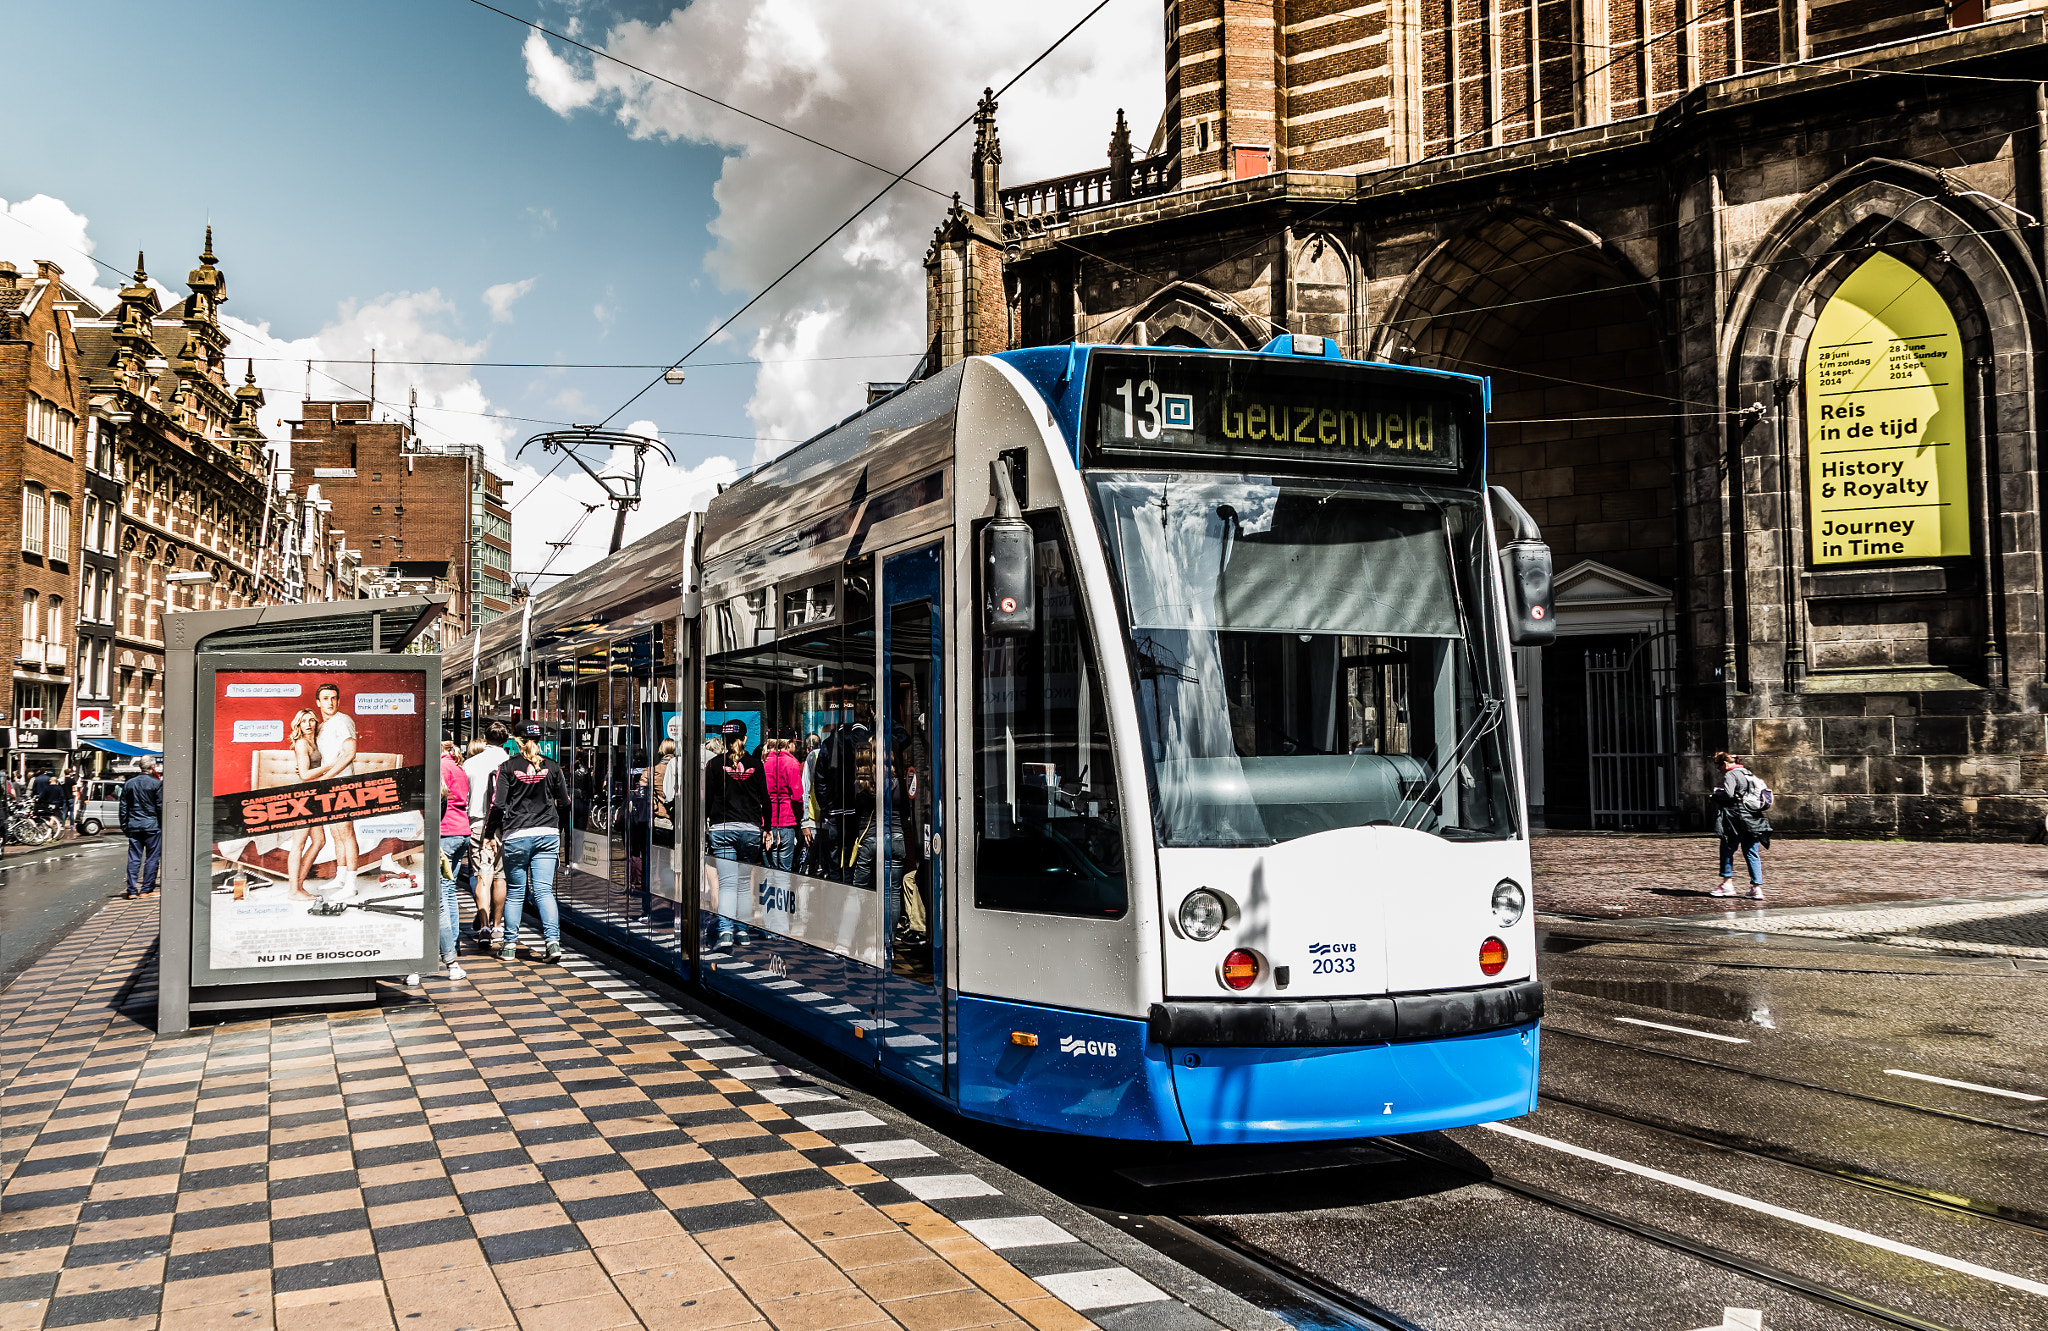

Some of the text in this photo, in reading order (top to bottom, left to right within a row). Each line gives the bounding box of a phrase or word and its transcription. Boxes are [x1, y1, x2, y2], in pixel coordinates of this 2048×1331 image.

[1831, 351, 1850, 362] juni
[1889, 343, 1926, 353] 28 June
[1889, 350, 1948, 362] until Sunday
[1819, 357, 1871, 369] t/m zondag
[1889, 361, 1927, 371] 14 Sept.
[1819, 368, 1854, 379] 14 sept.
[1889, 371, 1913, 380] 2014
[1819, 378, 1842, 387] 2014
[1116, 378, 1434, 452] 13 Geuzenveld
[1820, 402, 1866, 420] Reis
[1820, 418, 1918, 441] in de tijd
[1822, 461, 1904, 478] History
[1822, 478, 1929, 499] & Royalty
[1822, 520, 1915, 537] Journey
[1822, 539, 1904, 557] in Time
[298, 657, 347, 667] JCDecaux
[241, 776, 396, 806] CAMERON DIAZ JASON SEGEL
[242, 783, 399, 824] SEX TAPE
[246, 804, 402, 834] THEIR PRIVATES HAVE JUST GONE PUBLIC.
[776, 889, 797, 915] GVB
[257, 949, 382, 962] NU IN DE BIOSCOOP
[1331, 943, 1357, 954] GVB
[1312, 958, 1356, 975] 2033
[1087, 1040, 1117, 1057] GVB
